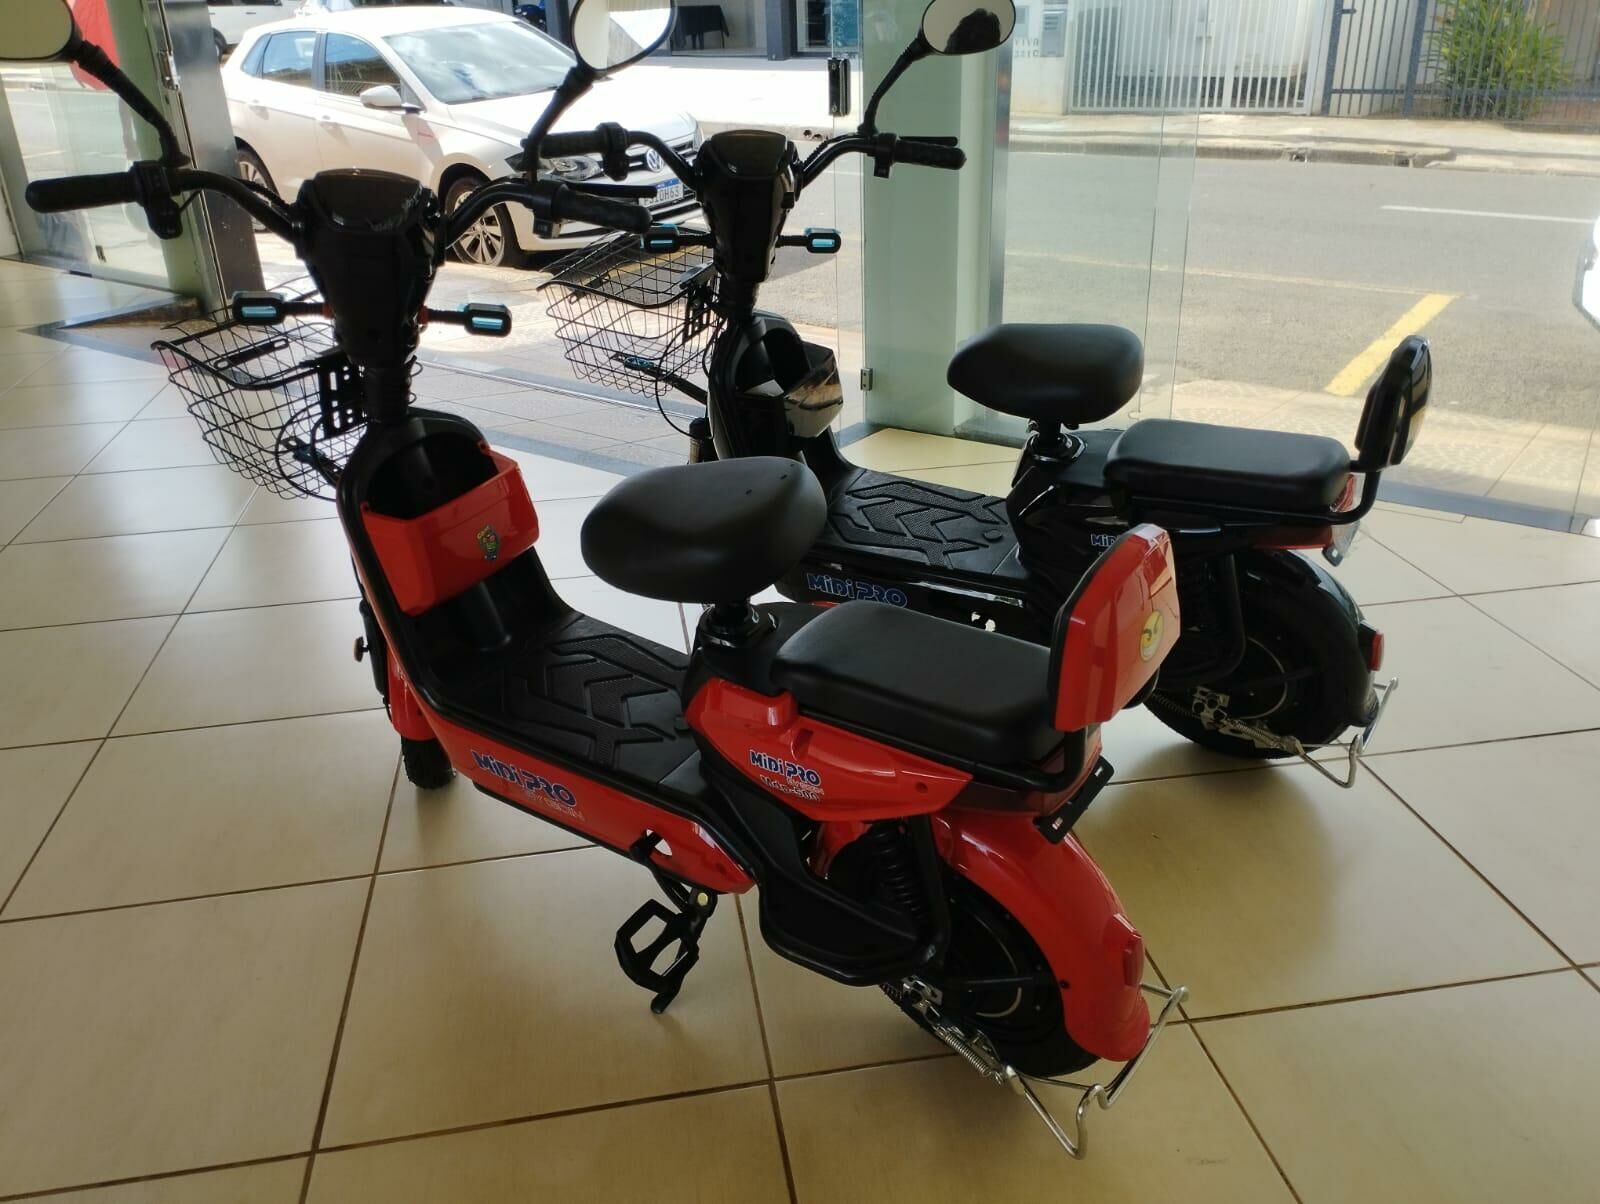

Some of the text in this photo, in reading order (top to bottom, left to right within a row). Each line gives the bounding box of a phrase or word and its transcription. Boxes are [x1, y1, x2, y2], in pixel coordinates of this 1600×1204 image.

[855, 581, 908, 608] PRO
[784, 760, 822, 787] PRO
[520, 768, 577, 807] PRO
